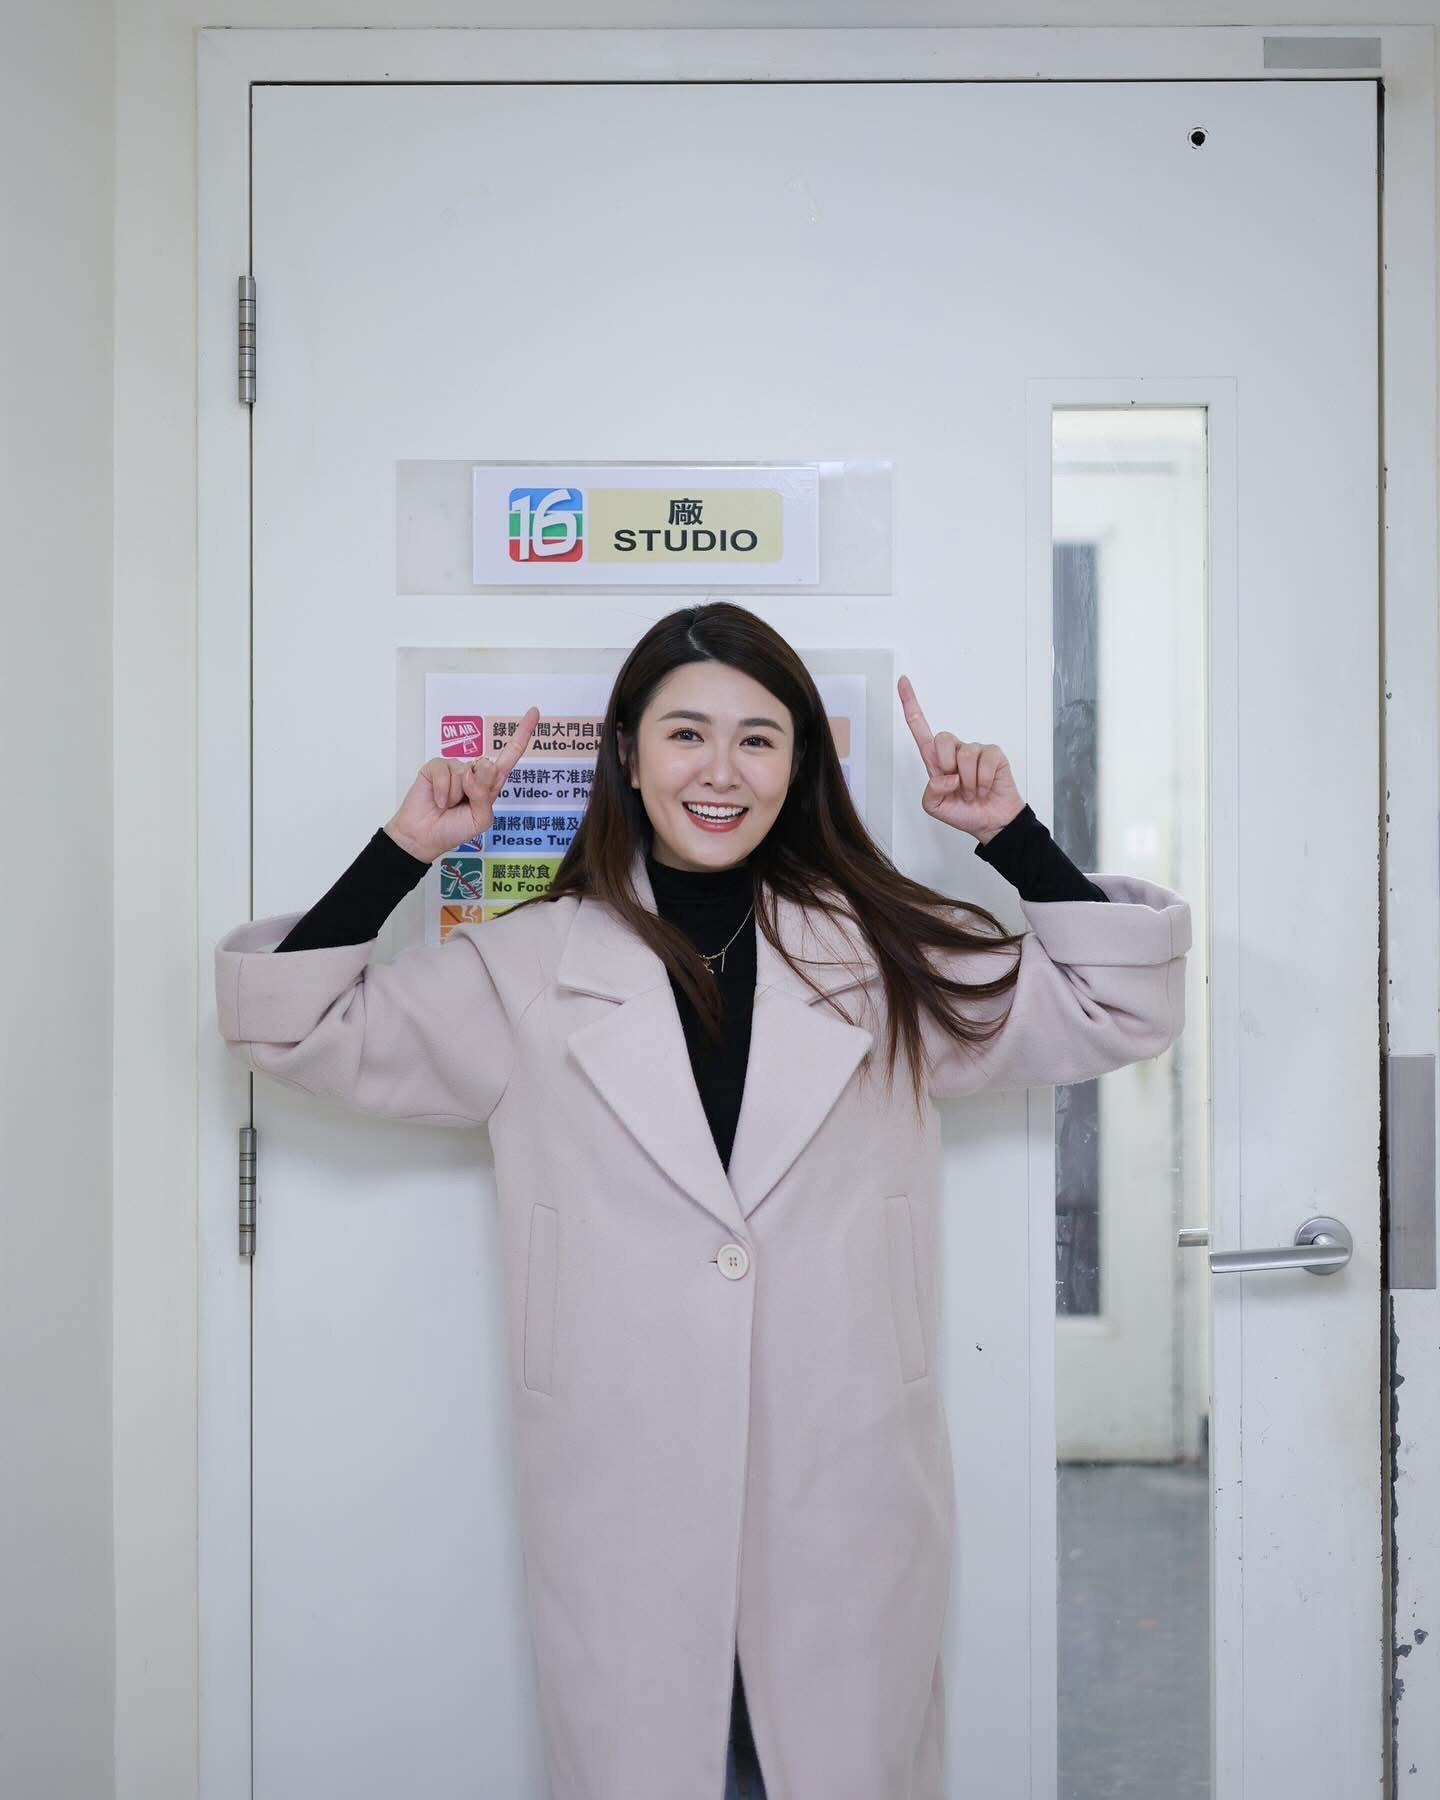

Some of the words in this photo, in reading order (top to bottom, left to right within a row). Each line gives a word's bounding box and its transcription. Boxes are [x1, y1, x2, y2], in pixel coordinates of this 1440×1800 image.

[668, 498, 703, 525] 廠
[511, 489, 577, 560] 16
[613, 529, 758, 552] STUDIO
[443, 725, 458, 739] ON
[459, 723, 476, 737] AIR
[514, 787, 553, 798] Video-
[556, 790, 570, 798] or
[493, 816, 579, 831] 請將傳呼機及
[493, 835, 543, 846] Please
[493, 864, 551, 879] 嚴禁飲食
[493, 881, 512, 892] No
